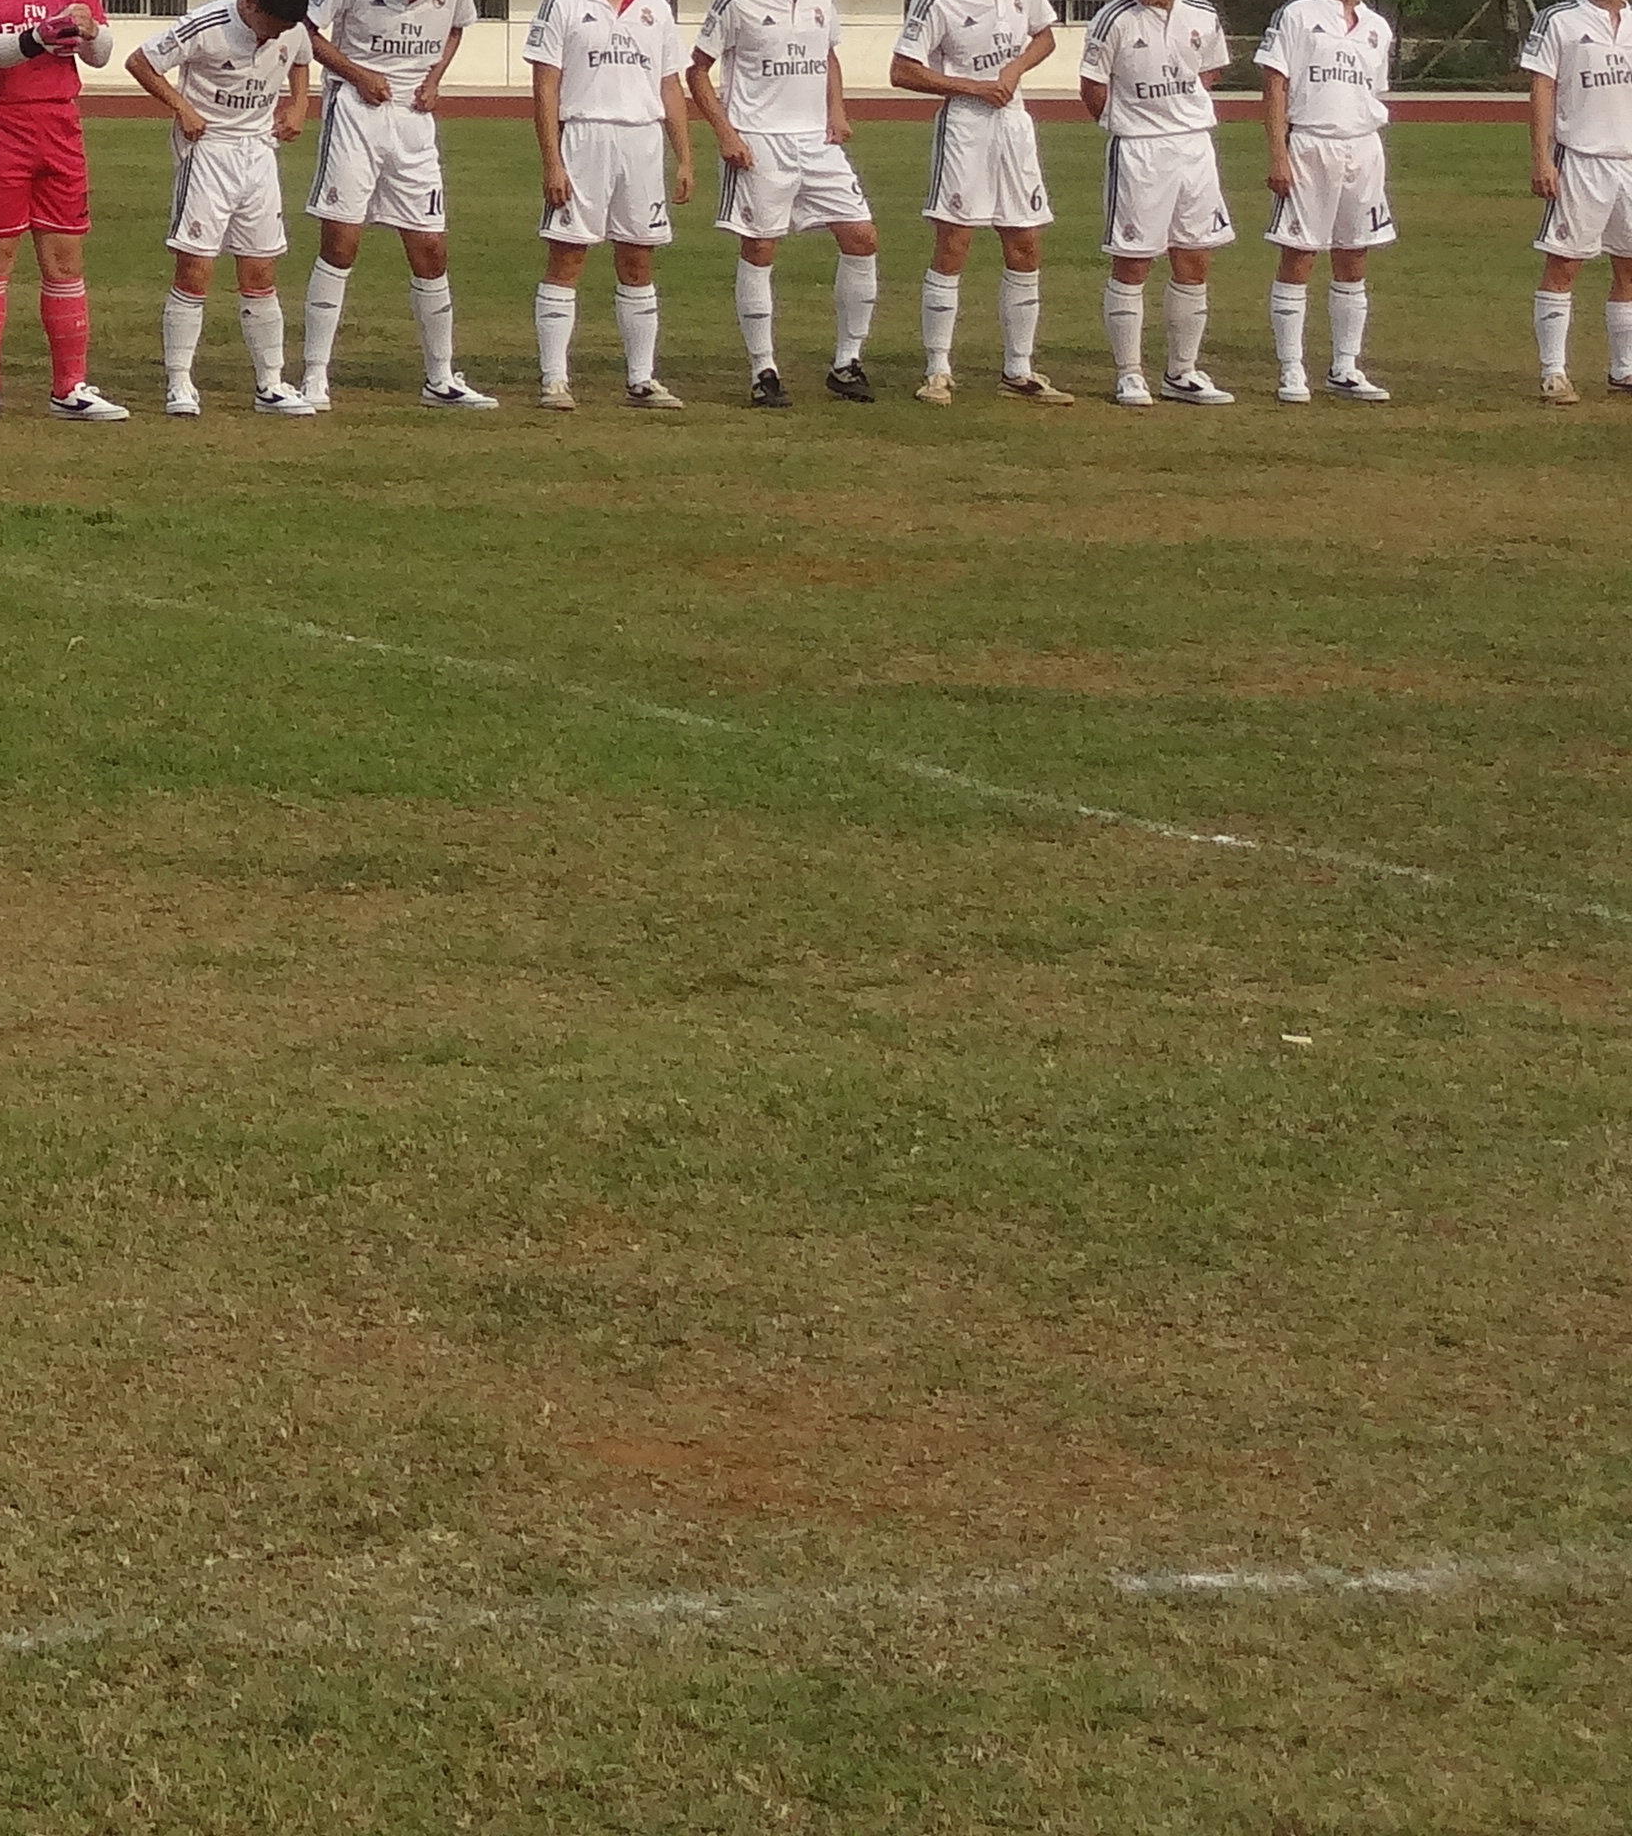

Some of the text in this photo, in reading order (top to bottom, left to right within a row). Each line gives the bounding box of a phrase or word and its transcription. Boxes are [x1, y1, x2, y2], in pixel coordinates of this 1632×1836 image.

[24, 4, 46, 19] Fly
[401, 23, 422, 37] Fly
[370, 35, 442, 55] Emirates
[993, 32, 1012, 45] Fly
[788, 43, 806, 58] Fly
[1336, 51, 1355, 67] Fly
[762, 57, 827, 77] Emirates
[1030, 185, 1042, 211] 6
